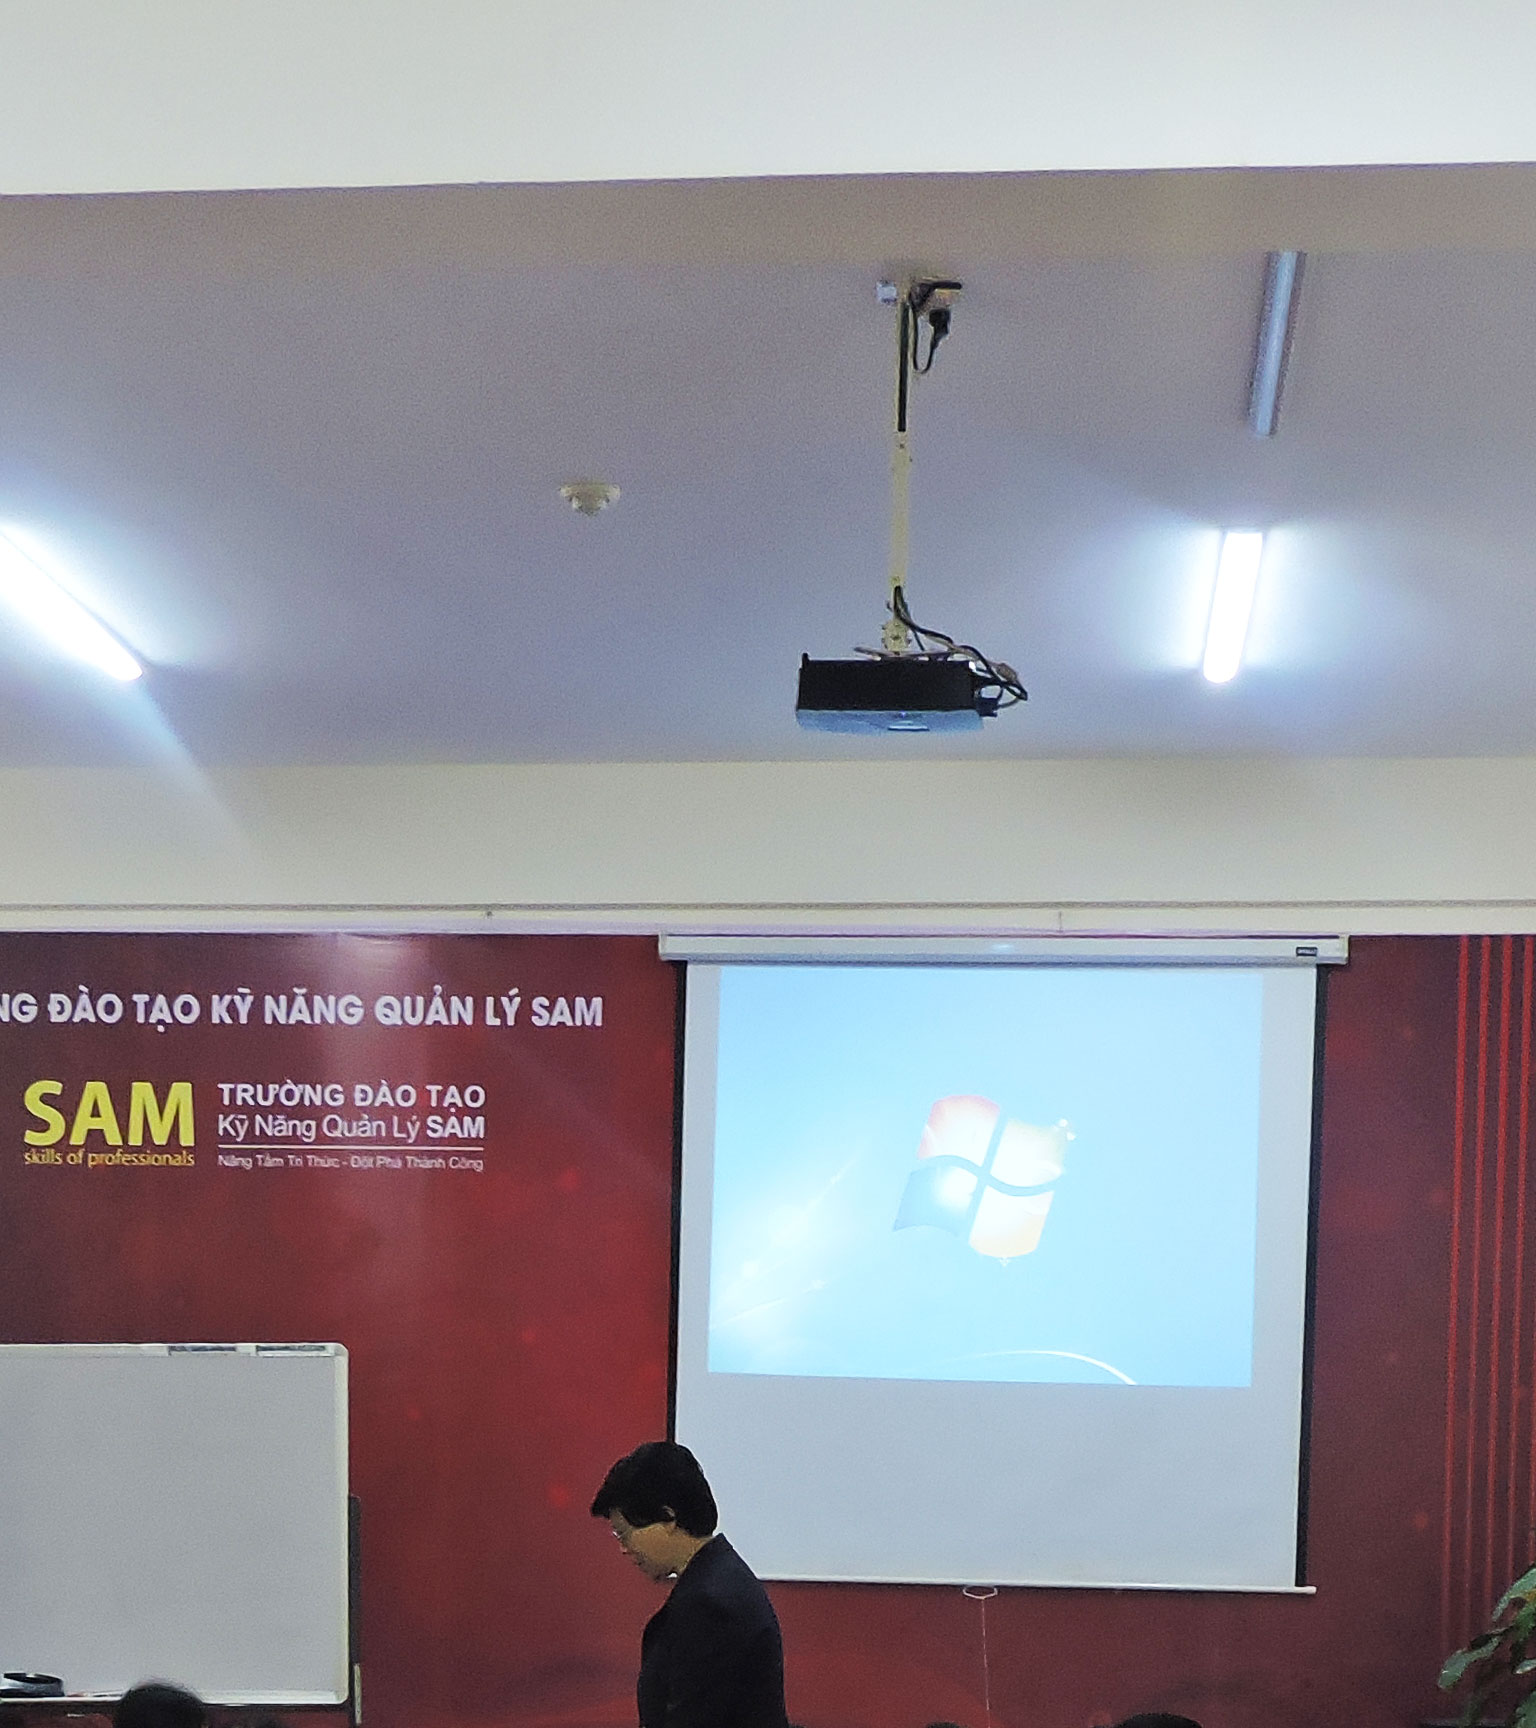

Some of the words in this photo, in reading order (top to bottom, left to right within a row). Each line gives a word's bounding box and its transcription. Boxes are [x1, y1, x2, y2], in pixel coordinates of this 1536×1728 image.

[47, 984, 125, 1025] ĐÀO
[132, 993, 201, 1033] TẠO
[211, 987, 255, 1025] KỸ
[264, 987, 365, 1027] NĂNG
[374, 984, 474, 1028] QUẢN
[485, 987, 522, 1028] LÝ
[531, 996, 604, 1028] SAM
[217, 1079, 346, 1107] TRƯỜNG
[354, 1079, 417, 1108] ĐÀO
[425, 1084, 486, 1113] TẠO
[24, 1080, 196, 1147] SAM
[218, 1113, 249, 1142] Kỹ
[255, 1114, 316, 1142] Năng
[322, 1113, 386, 1138] Quản
[392, 1115, 421, 1143] Lý
[426, 1115, 485, 1139] SAM
[24, 1148, 63, 1165] skills
[66, 1148, 86, 1165] of
[88, 1149, 196, 1168] professionals
